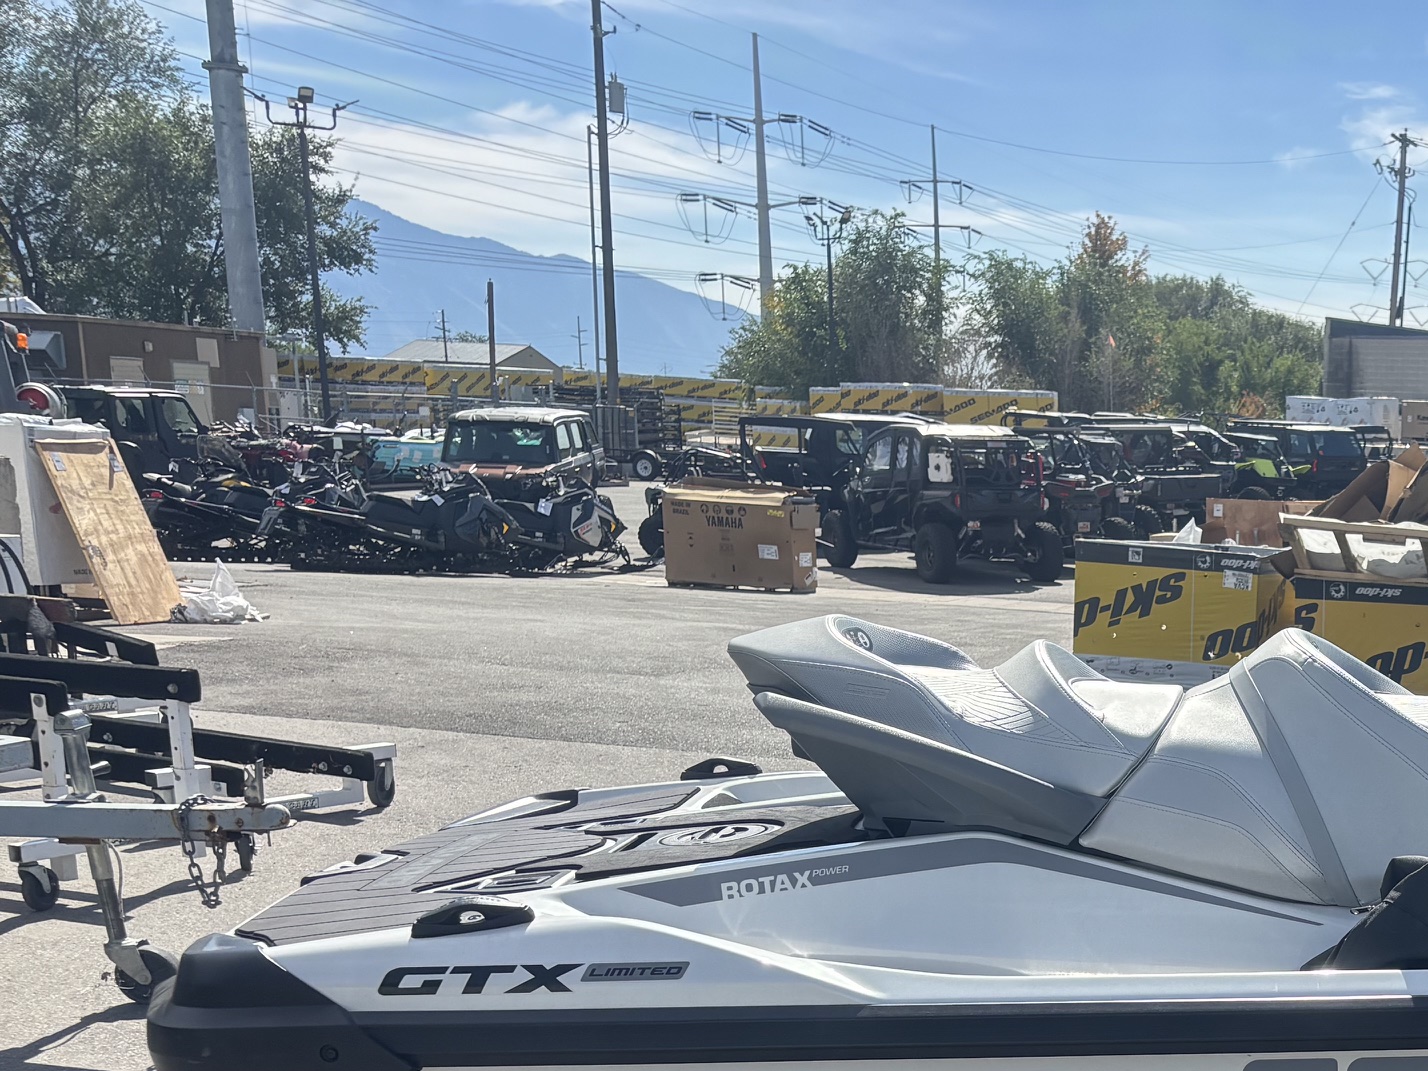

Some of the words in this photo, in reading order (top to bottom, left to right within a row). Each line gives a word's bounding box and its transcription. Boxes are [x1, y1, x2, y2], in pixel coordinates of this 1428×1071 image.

[706, 516, 744, 530] YAMAHA
[1355, 586, 1402, 597] ski-doo
[721, 870, 817, 902] ROTAX
[812, 864, 850, 878] POWER
[378, 964, 586, 996] GTX
[588, 964, 684, 978] LIMITED
